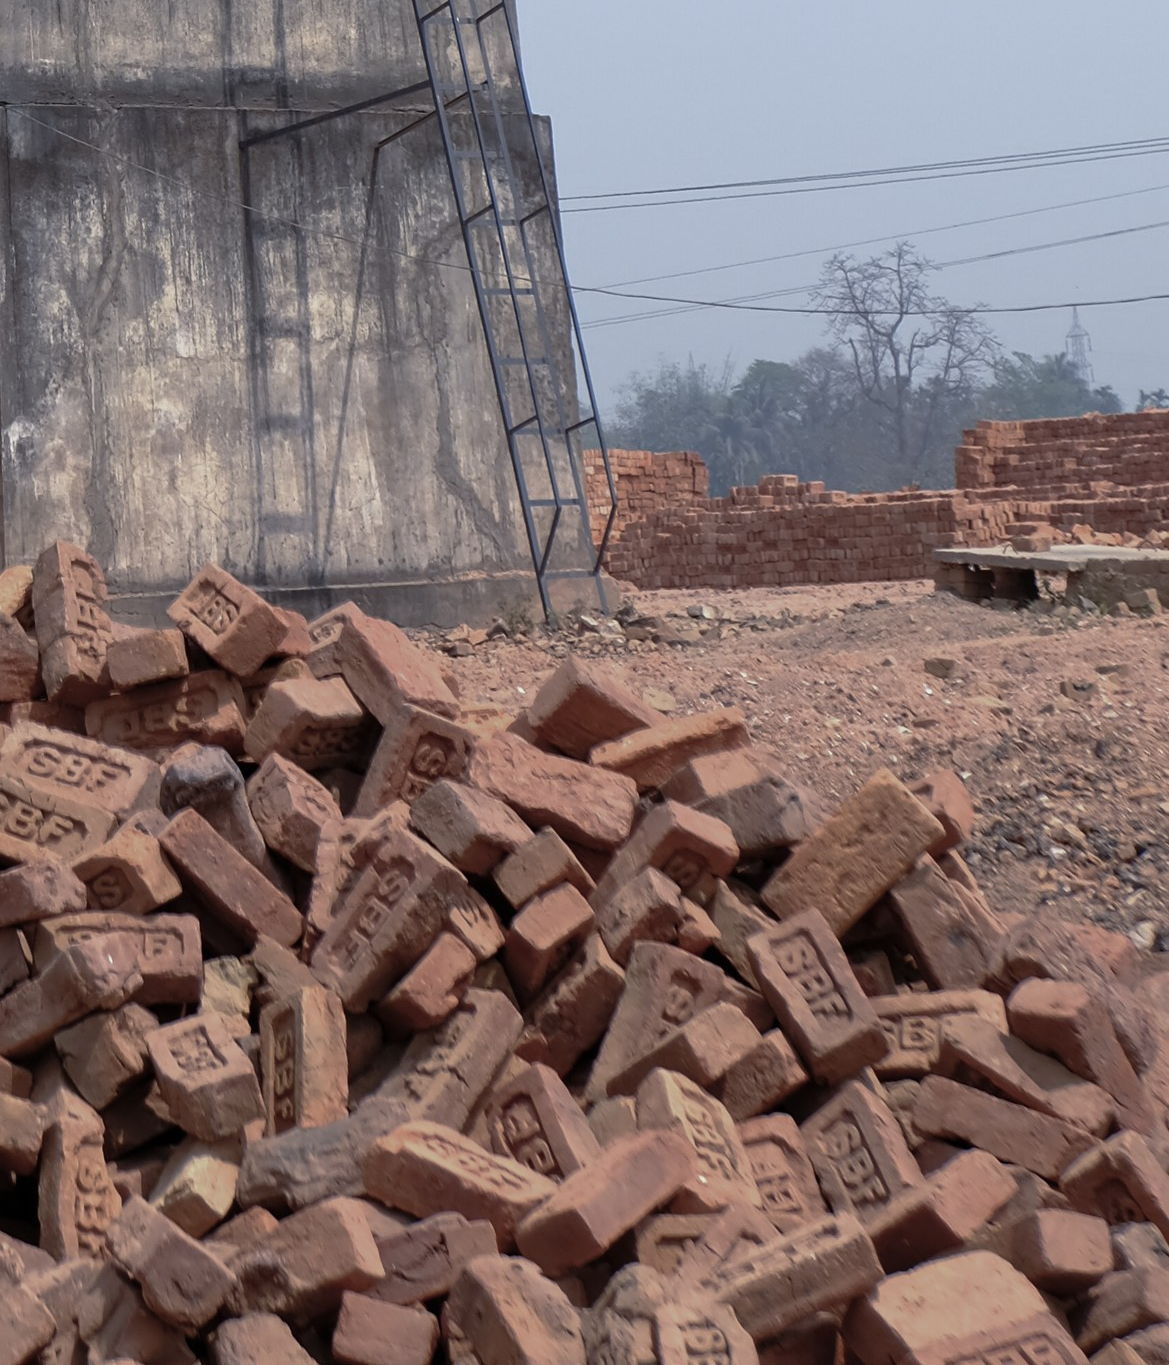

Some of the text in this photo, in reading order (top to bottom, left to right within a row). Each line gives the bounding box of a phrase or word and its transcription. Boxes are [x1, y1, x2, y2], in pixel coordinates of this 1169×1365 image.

[26, 746, 120, 791] SBF
[774, 944, 850, 1016] SBF
[825, 1123, 888, 1205] SBF
